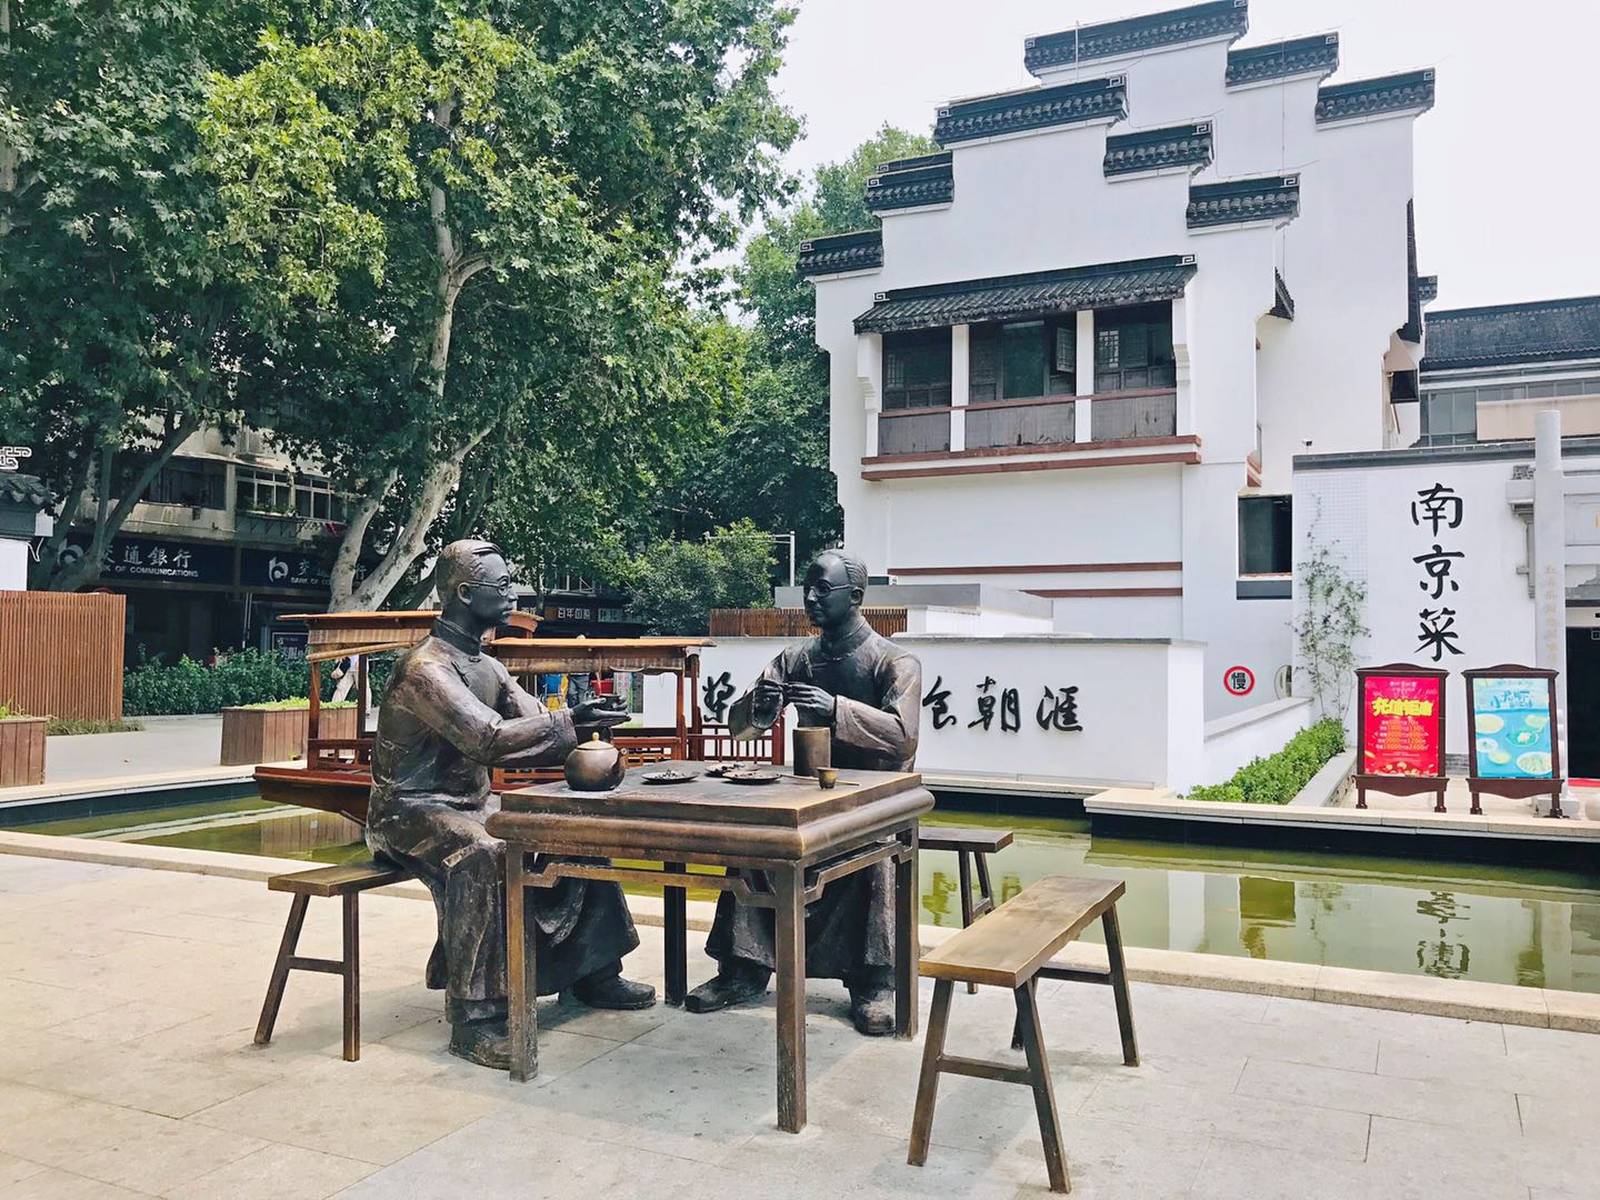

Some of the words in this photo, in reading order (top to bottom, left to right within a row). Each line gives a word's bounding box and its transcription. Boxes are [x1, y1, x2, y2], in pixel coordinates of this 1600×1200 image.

[130, 566, 199, 577] COMMUNICATIONS
[1412, 482, 1465, 661] 南京菜
[1231, 672, 1246, 690] 慢
